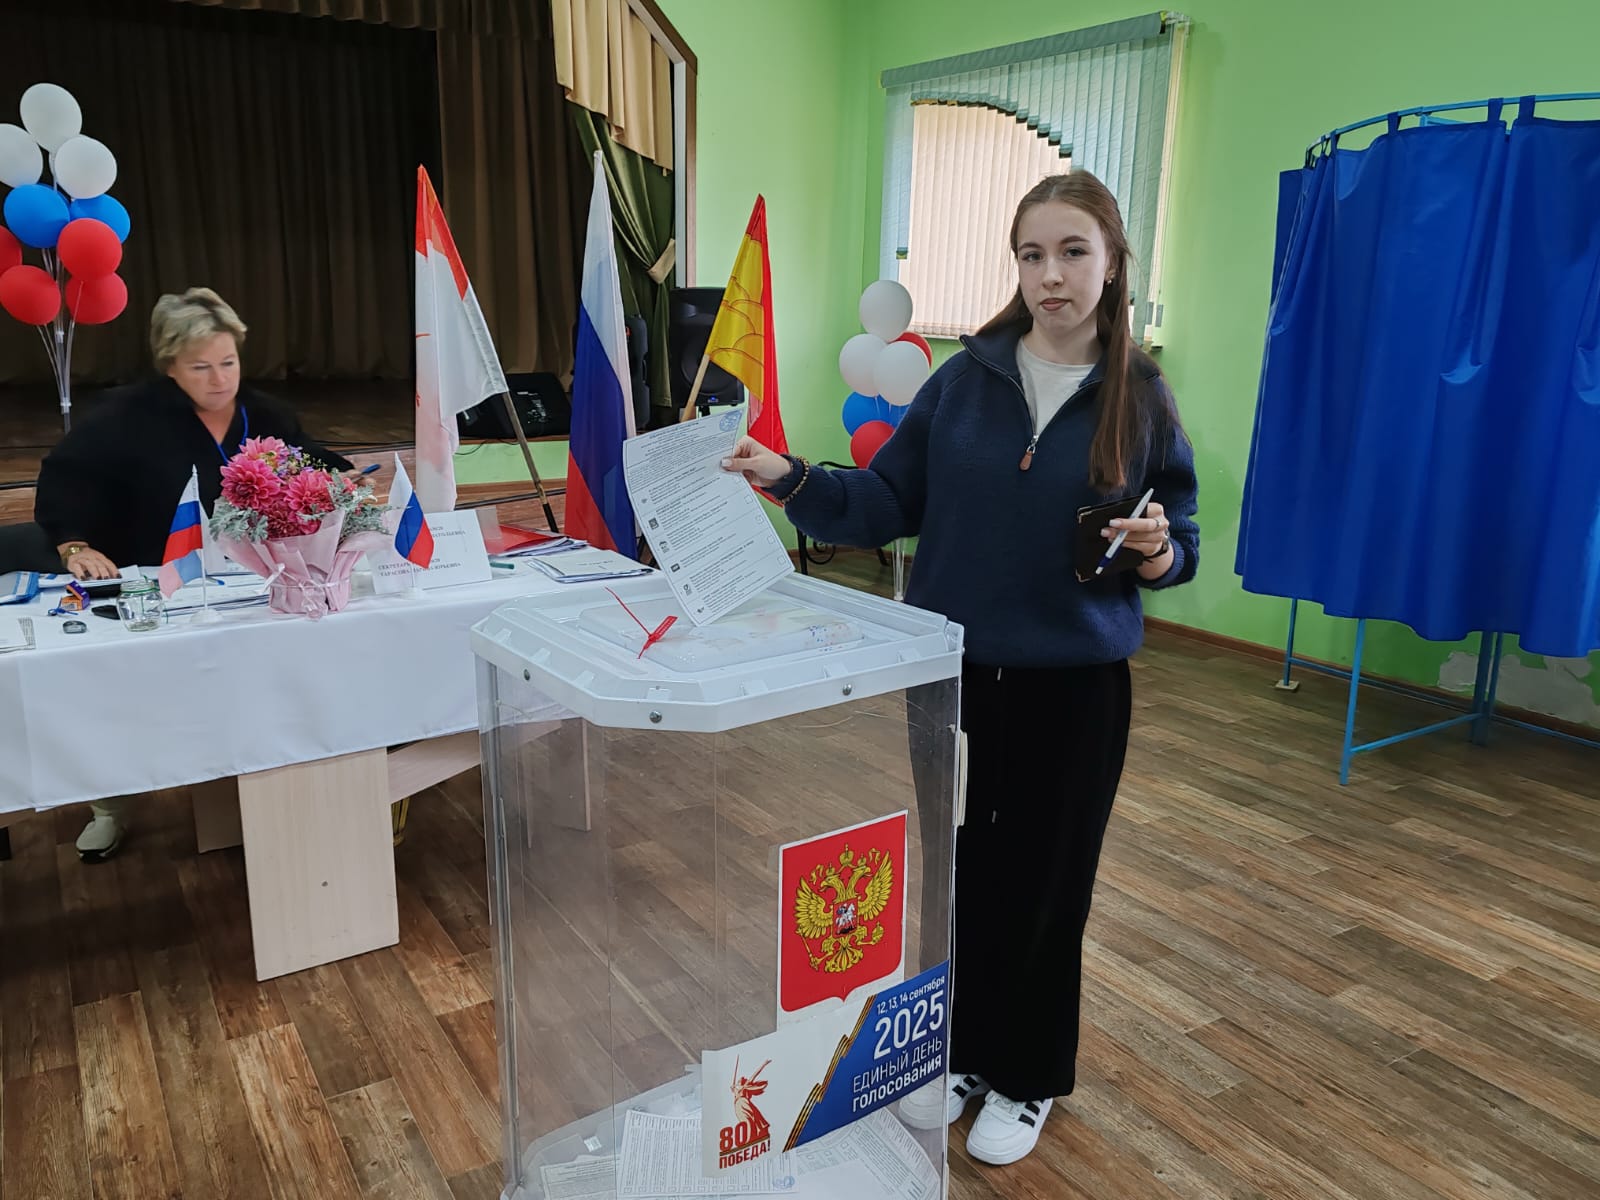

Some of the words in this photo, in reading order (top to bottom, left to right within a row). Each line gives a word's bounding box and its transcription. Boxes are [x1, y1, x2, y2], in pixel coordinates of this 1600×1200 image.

[877, 1003, 888, 1016] 12,
[888, 999, 898, 1011] 13,
[899, 994, 909, 1007] 14
[909, 975, 945, 1000] сентября
[873, 990, 944, 1060] 2025
[854, 1051, 909, 1092] ЕДИНЫЙ
[912, 1036, 943, 1068] ДЕНЬ
[719, 1140, 771, 1169] ПОБЕДА!
[720, 1126, 747, 1152] 80
